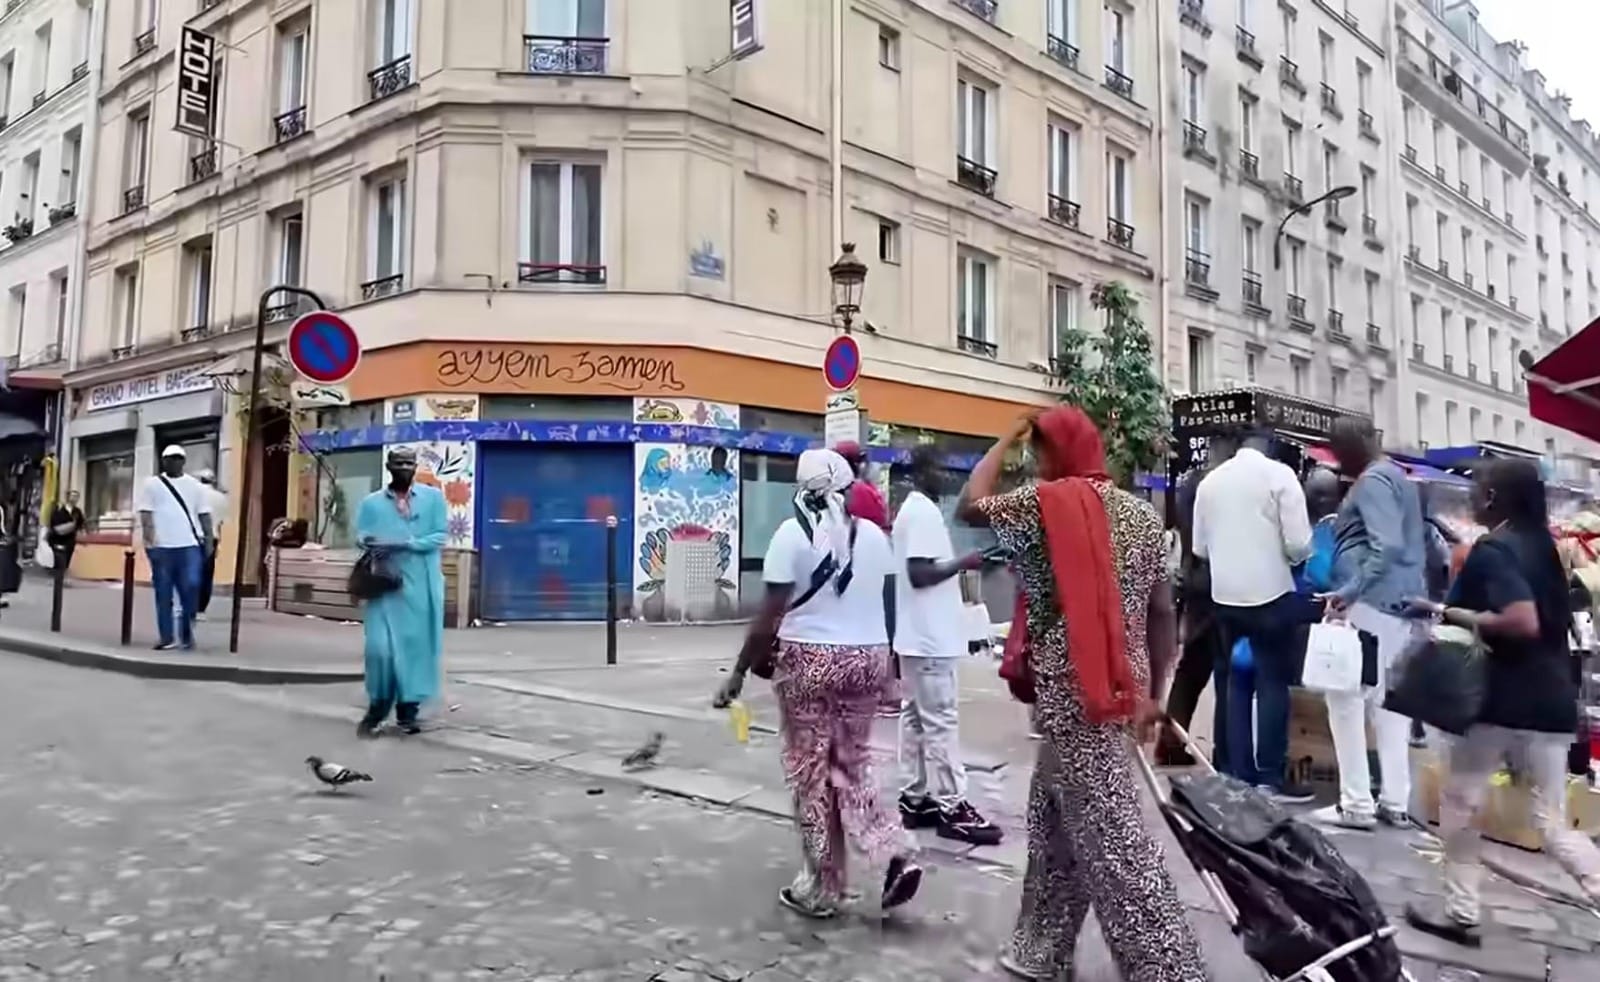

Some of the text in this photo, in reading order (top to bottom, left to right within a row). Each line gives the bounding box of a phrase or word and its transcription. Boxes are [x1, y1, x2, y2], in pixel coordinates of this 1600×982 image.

[180, 31, 211, 133] HOTEL
[436, 349, 573, 389] ayyem
[93, 384, 123, 406] GRAND
[128, 376, 160, 398] HOTEL
[1191, 399, 1235, 413] Atlas
